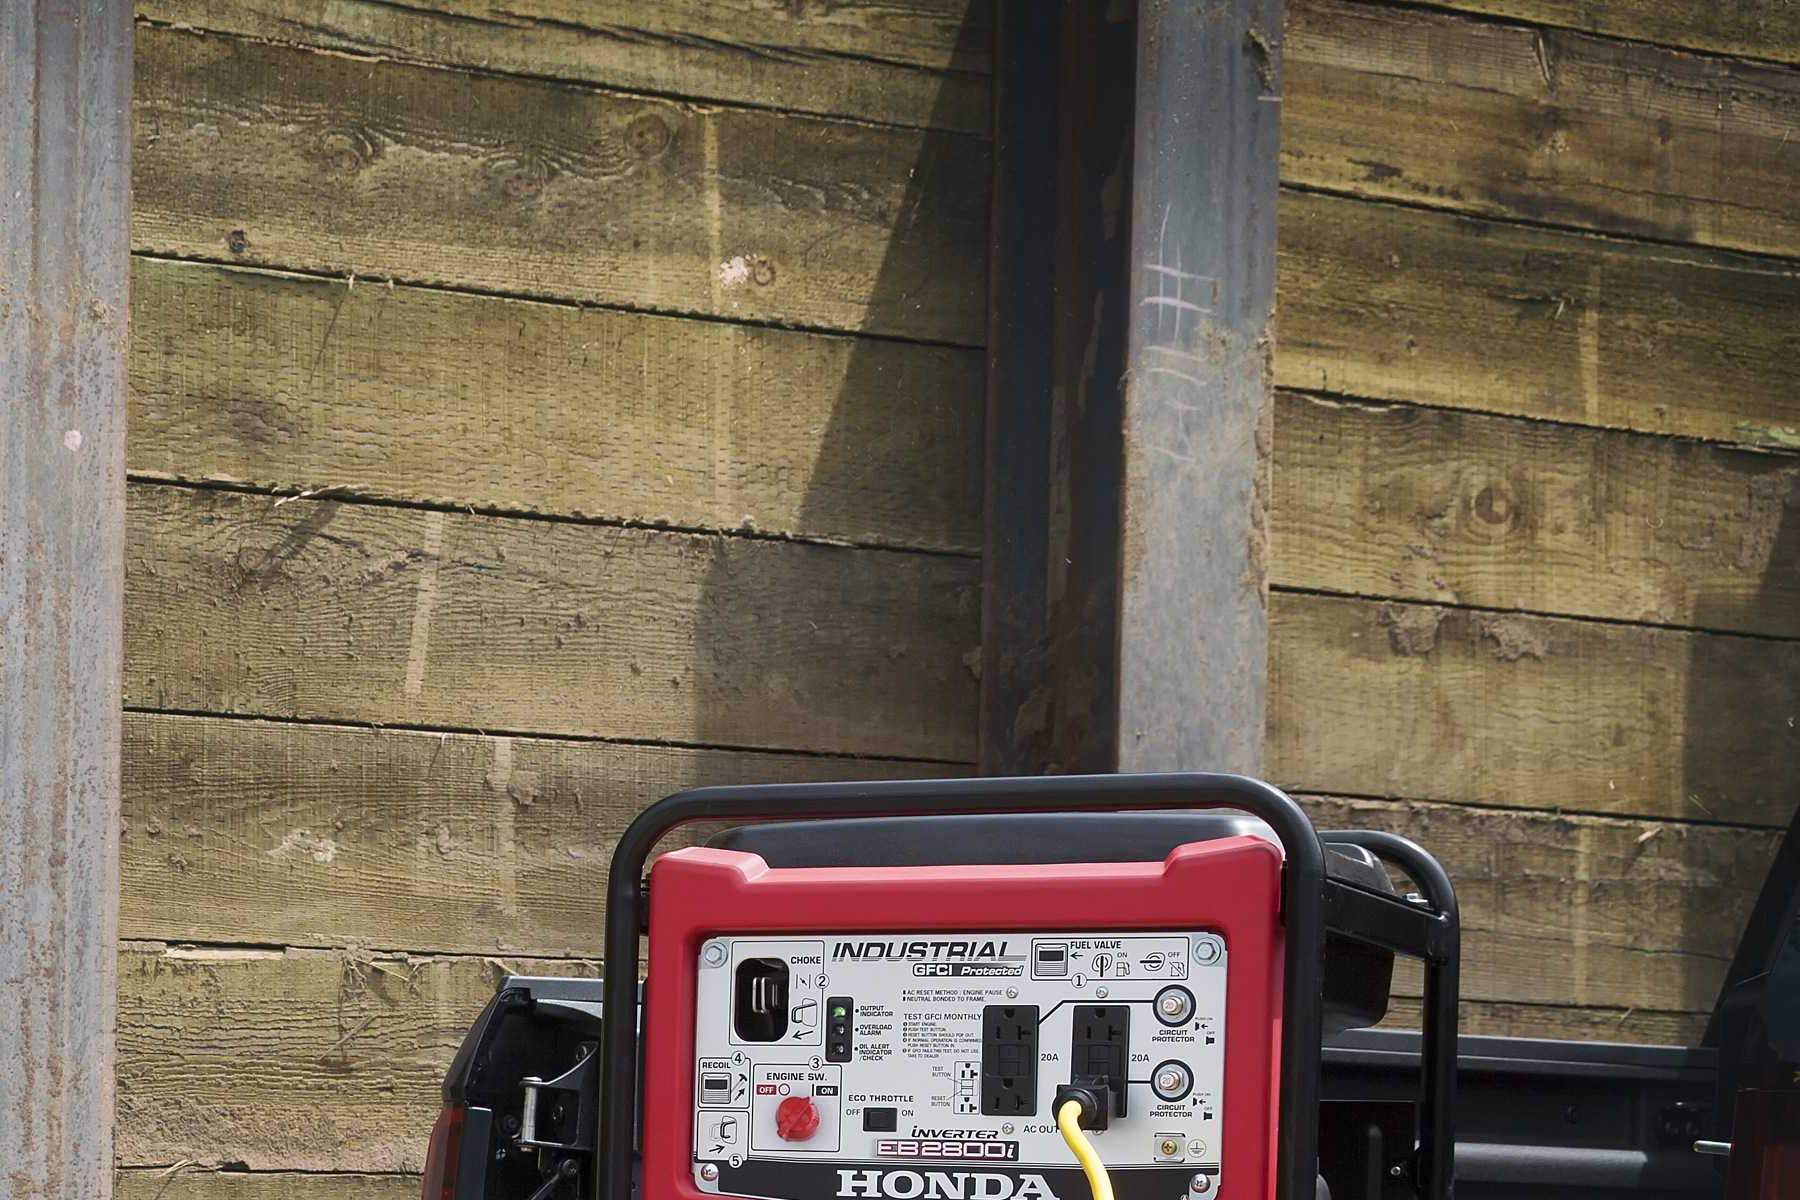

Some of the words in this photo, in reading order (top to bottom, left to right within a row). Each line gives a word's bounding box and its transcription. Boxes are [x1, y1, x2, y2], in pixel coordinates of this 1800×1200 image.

[1070, 941, 1091, 949] FUEL
[1095, 941, 1121, 949] VALVE
[832, 941, 1027, 962] INDUSTRIAL
[790, 956, 821, 965] CHOKE
[913, 964, 953, 976] GFCI
[961, 966, 1023, 976] Protected
[818, 975, 826, 987] 2
[904, 1013, 921, 1021] TEST
[924, 1013, 942, 1021] GFCI
[944, 1013, 982, 1021] MONTHLY
[734, 1053, 743, 1064] 4
[1041, 1053, 1059, 1062] 20A
[1131, 1054, 1149, 1063] 20A
[811, 1057, 820, 1069] 3
[766, 1073, 805, 1081] ENGINE
[808, 1073, 828, 1081] SW.
[759, 1086, 775, 1094] OFF
[821, 1087, 834, 1095] ON
[1023, 1126, 1037, 1134] AC
[731, 1155, 740, 1167] 5
